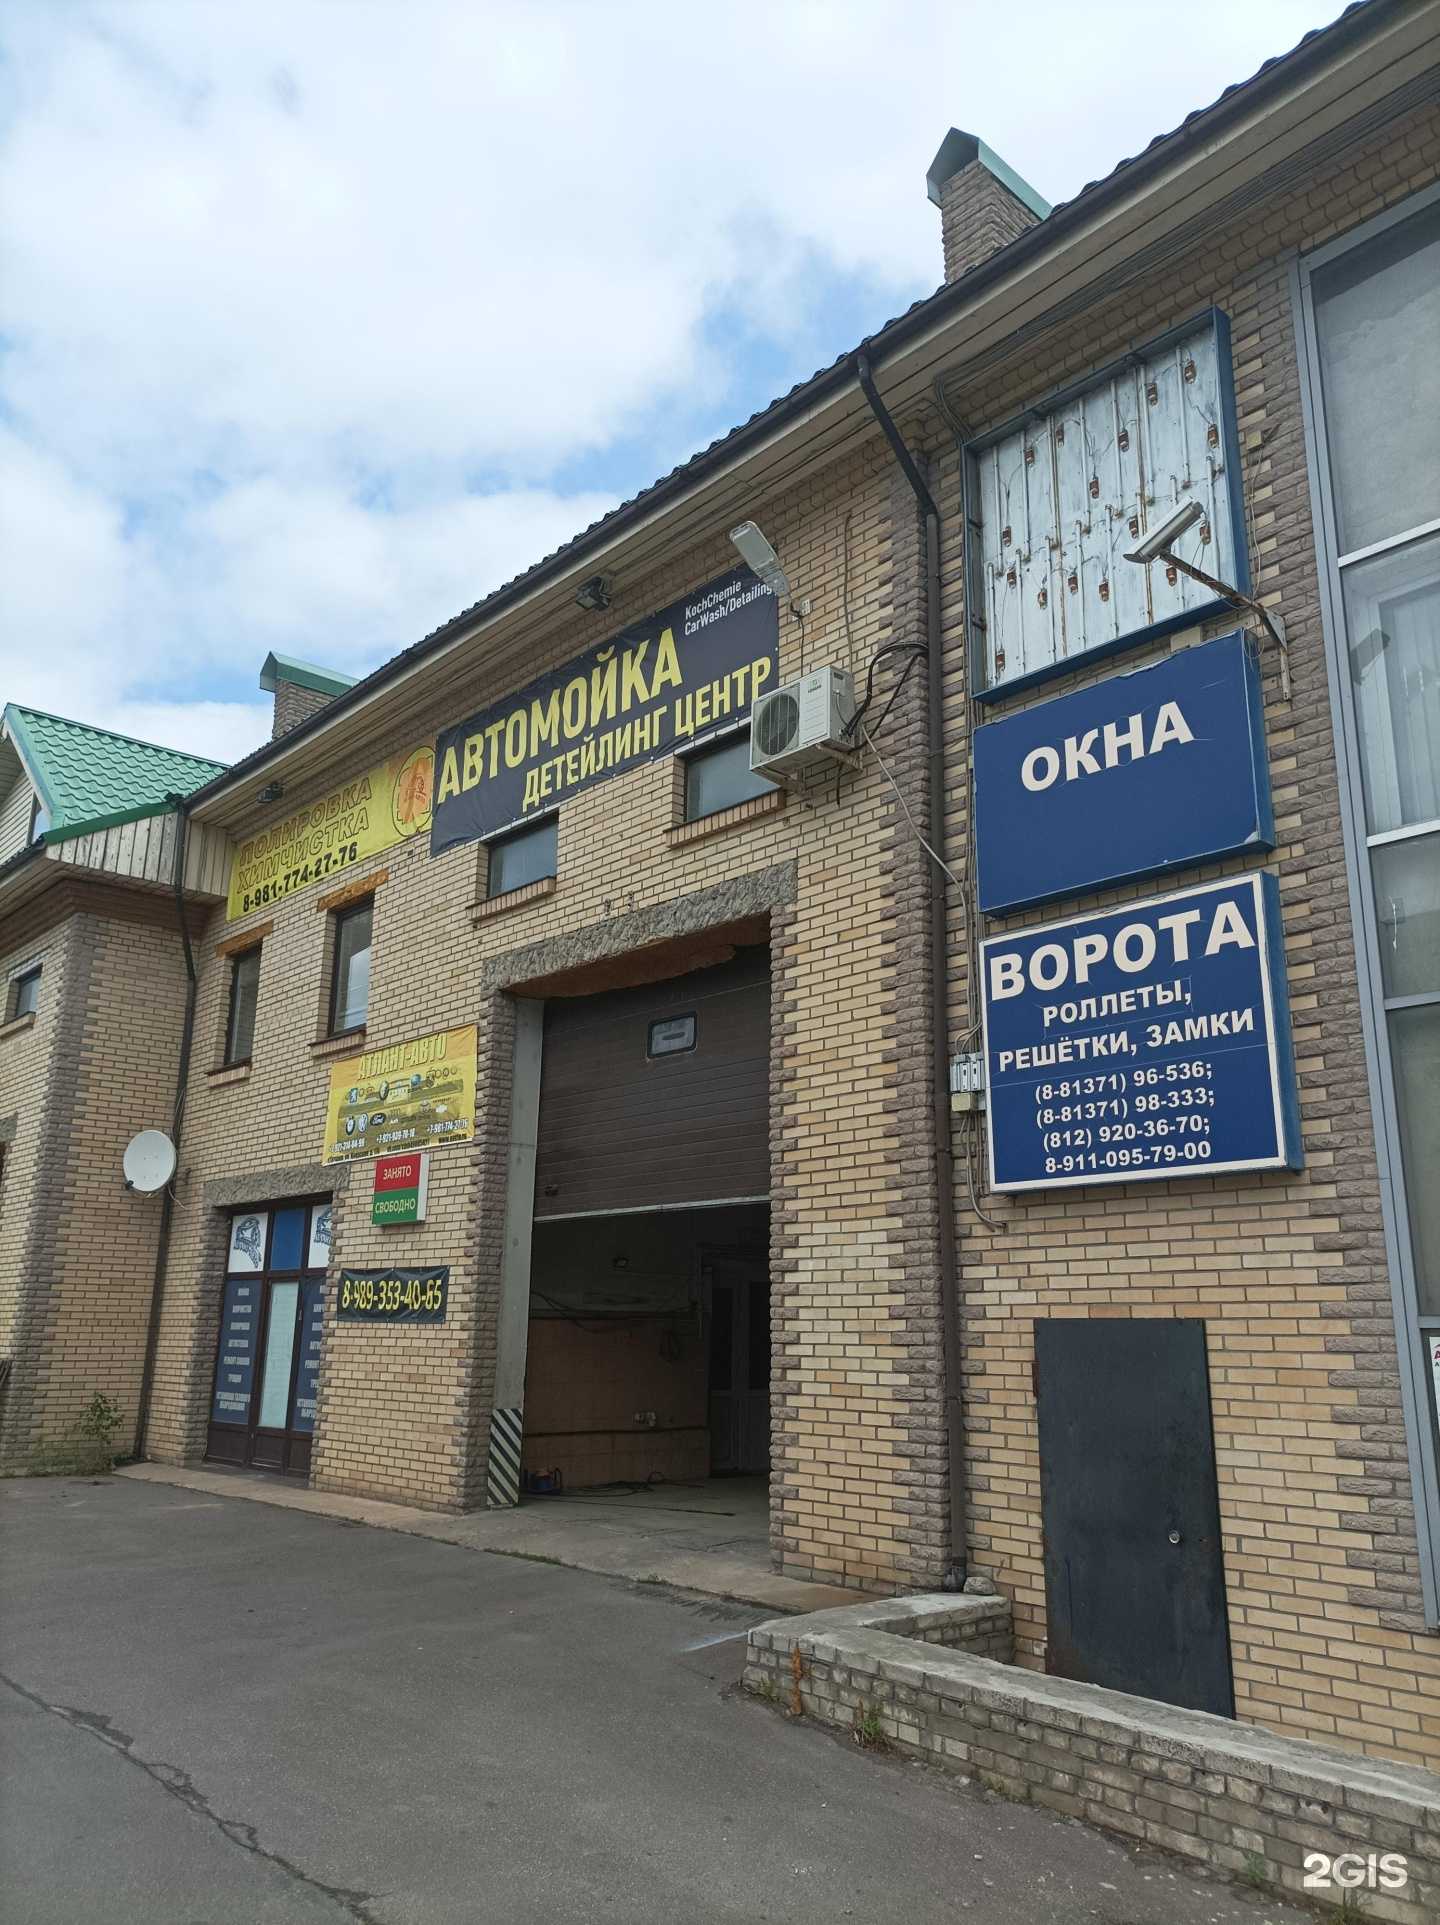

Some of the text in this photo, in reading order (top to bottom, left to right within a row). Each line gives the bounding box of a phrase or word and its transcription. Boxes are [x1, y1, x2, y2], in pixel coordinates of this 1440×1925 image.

[685, 581, 742, 620] KochChemie
[438, 628, 683, 804] АВТОМОЙКА
[522, 656, 771, 813] ДЕТЕЙЛИНГ ЦЕНТР
[1021, 701, 1195, 792] ОКНА
[239, 777, 372, 867] ПОЛИРОВКА
[237, 807, 369, 894] ХИМЧИСТКА
[243, 842, 358, 912] 8-981-774-27-76
[990, 901, 1256, 1001] ВОРОТА
[1043, 980, 1192, 1027] РОЛЛЕТЫ,
[999, 1008, 1254, 1072] РЕШЁТКИ, ЗАМКИ
[1035, 1061, 1213, 1104] (8-81371) 96-536;
[1036, 1087, 1215, 1129] (8-81371) 98-333;
[1043, 1115, 1211, 1152] (812) 920-36-70;
[1045, 1141, 1212, 1173] 8-911-095-79-00
[383, 1165, 411, 1180] ЗАНЯТО
[375, 1198, 416, 1214] СВОБОДНО
[342, 1279, 442, 1310] 8-989-353-40-65
